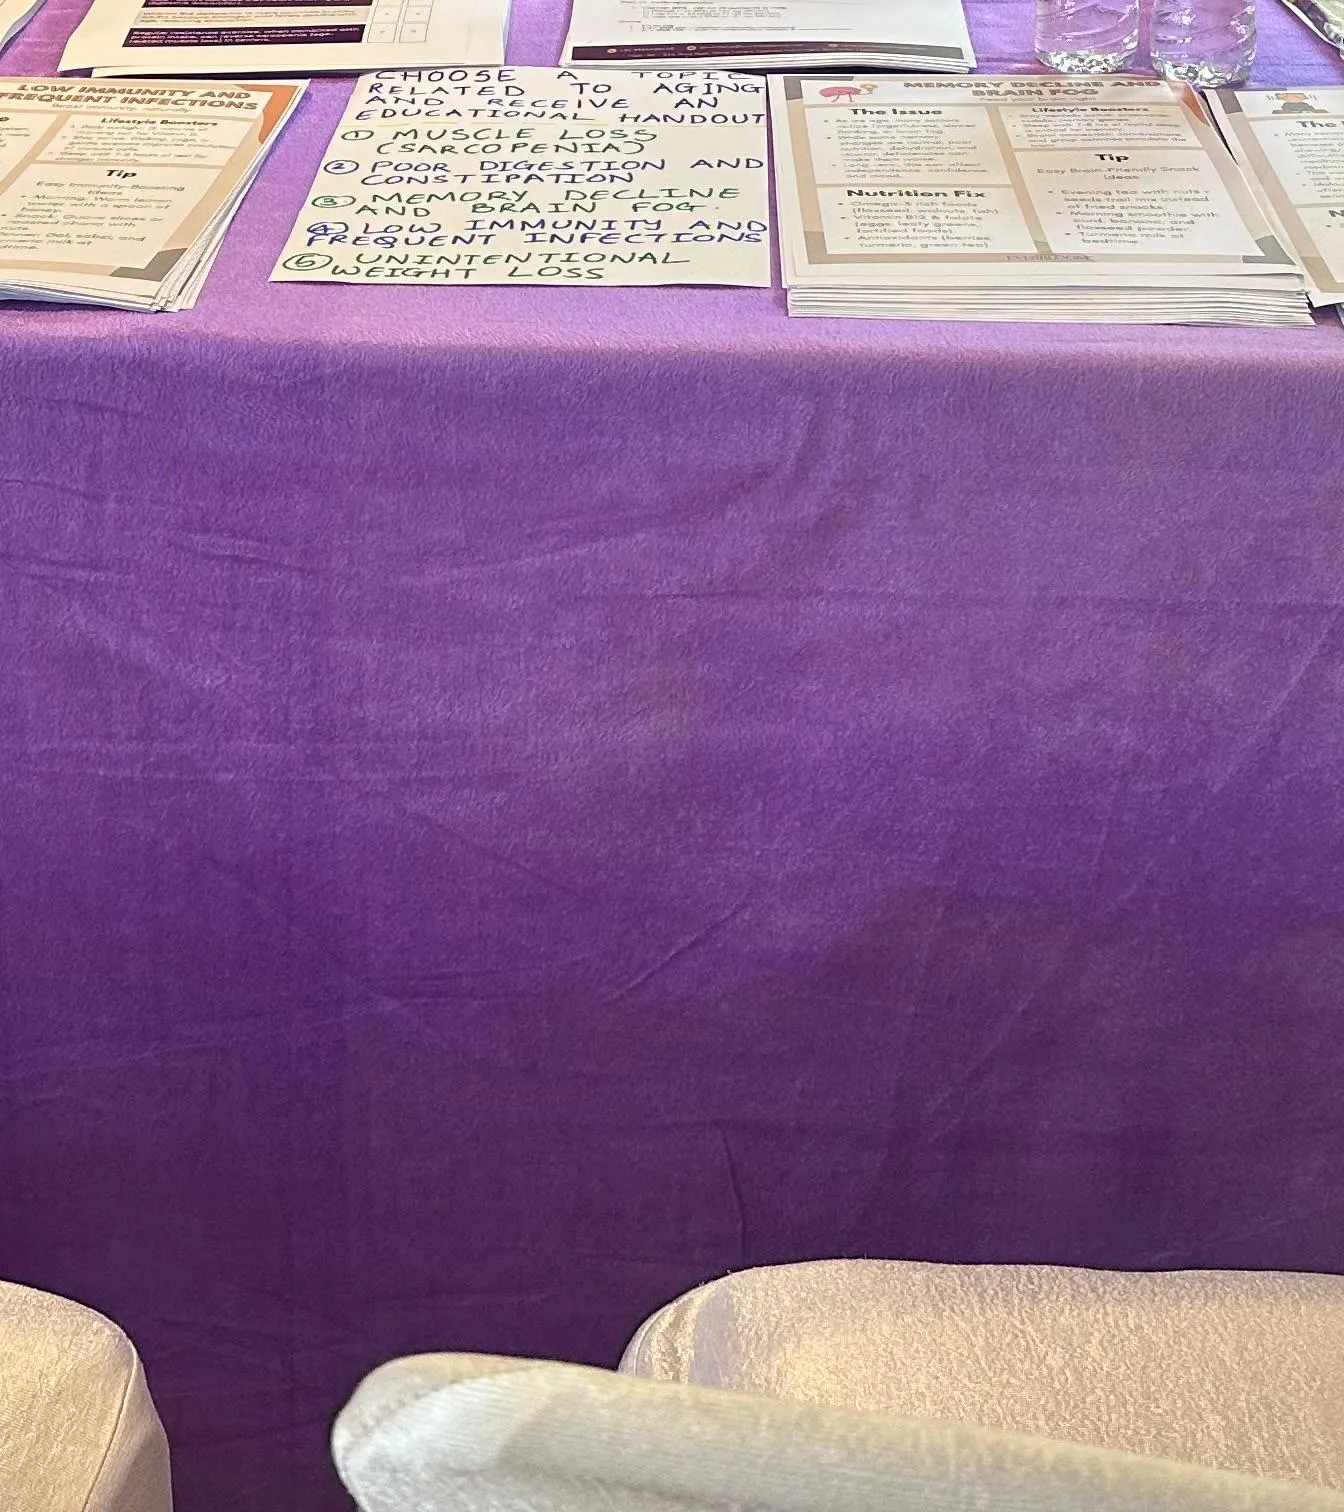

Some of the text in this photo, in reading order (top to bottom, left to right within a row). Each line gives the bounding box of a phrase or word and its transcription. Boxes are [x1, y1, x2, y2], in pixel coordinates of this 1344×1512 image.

[376, 69, 753, 82] CHOOSE A TOPIC
[17, 84, 251, 99] LOW IMMUNITY AND
[369, 83, 763, 96] RELATED TO AGING
[119, 96, 259, 110] INFECTIONS
[366, 96, 717, 108] AND RECEIVE AN
[356, 109, 764, 124] EDUCATIONAL HANDOUT
[393, 128, 657, 141] MUSCLE LOSS
[377, 141, 644, 154] (SARCOPENIA)
[1094, 153, 1129, 162] Tip
[371, 158, 763, 173] POOR DIGESTION AND
[105, 169, 137, 178] Tip
[361, 173, 633, 185] CONSTIPATION
[372, 188, 739, 204] MEMORY DECLINE
[846, 190, 949, 198] Nutrition
[355, 205, 430, 217] AND
[472, 202, 596, 213] BRAIN
[363, 219, 767, 234] LOW IMMUNITY AND
[306, 233, 761, 248] FREQUENT INFECTIONS
[356, 252, 690, 265] UNINTENTIONAL
[332, 265, 604, 279] WEIGHT LOSS
